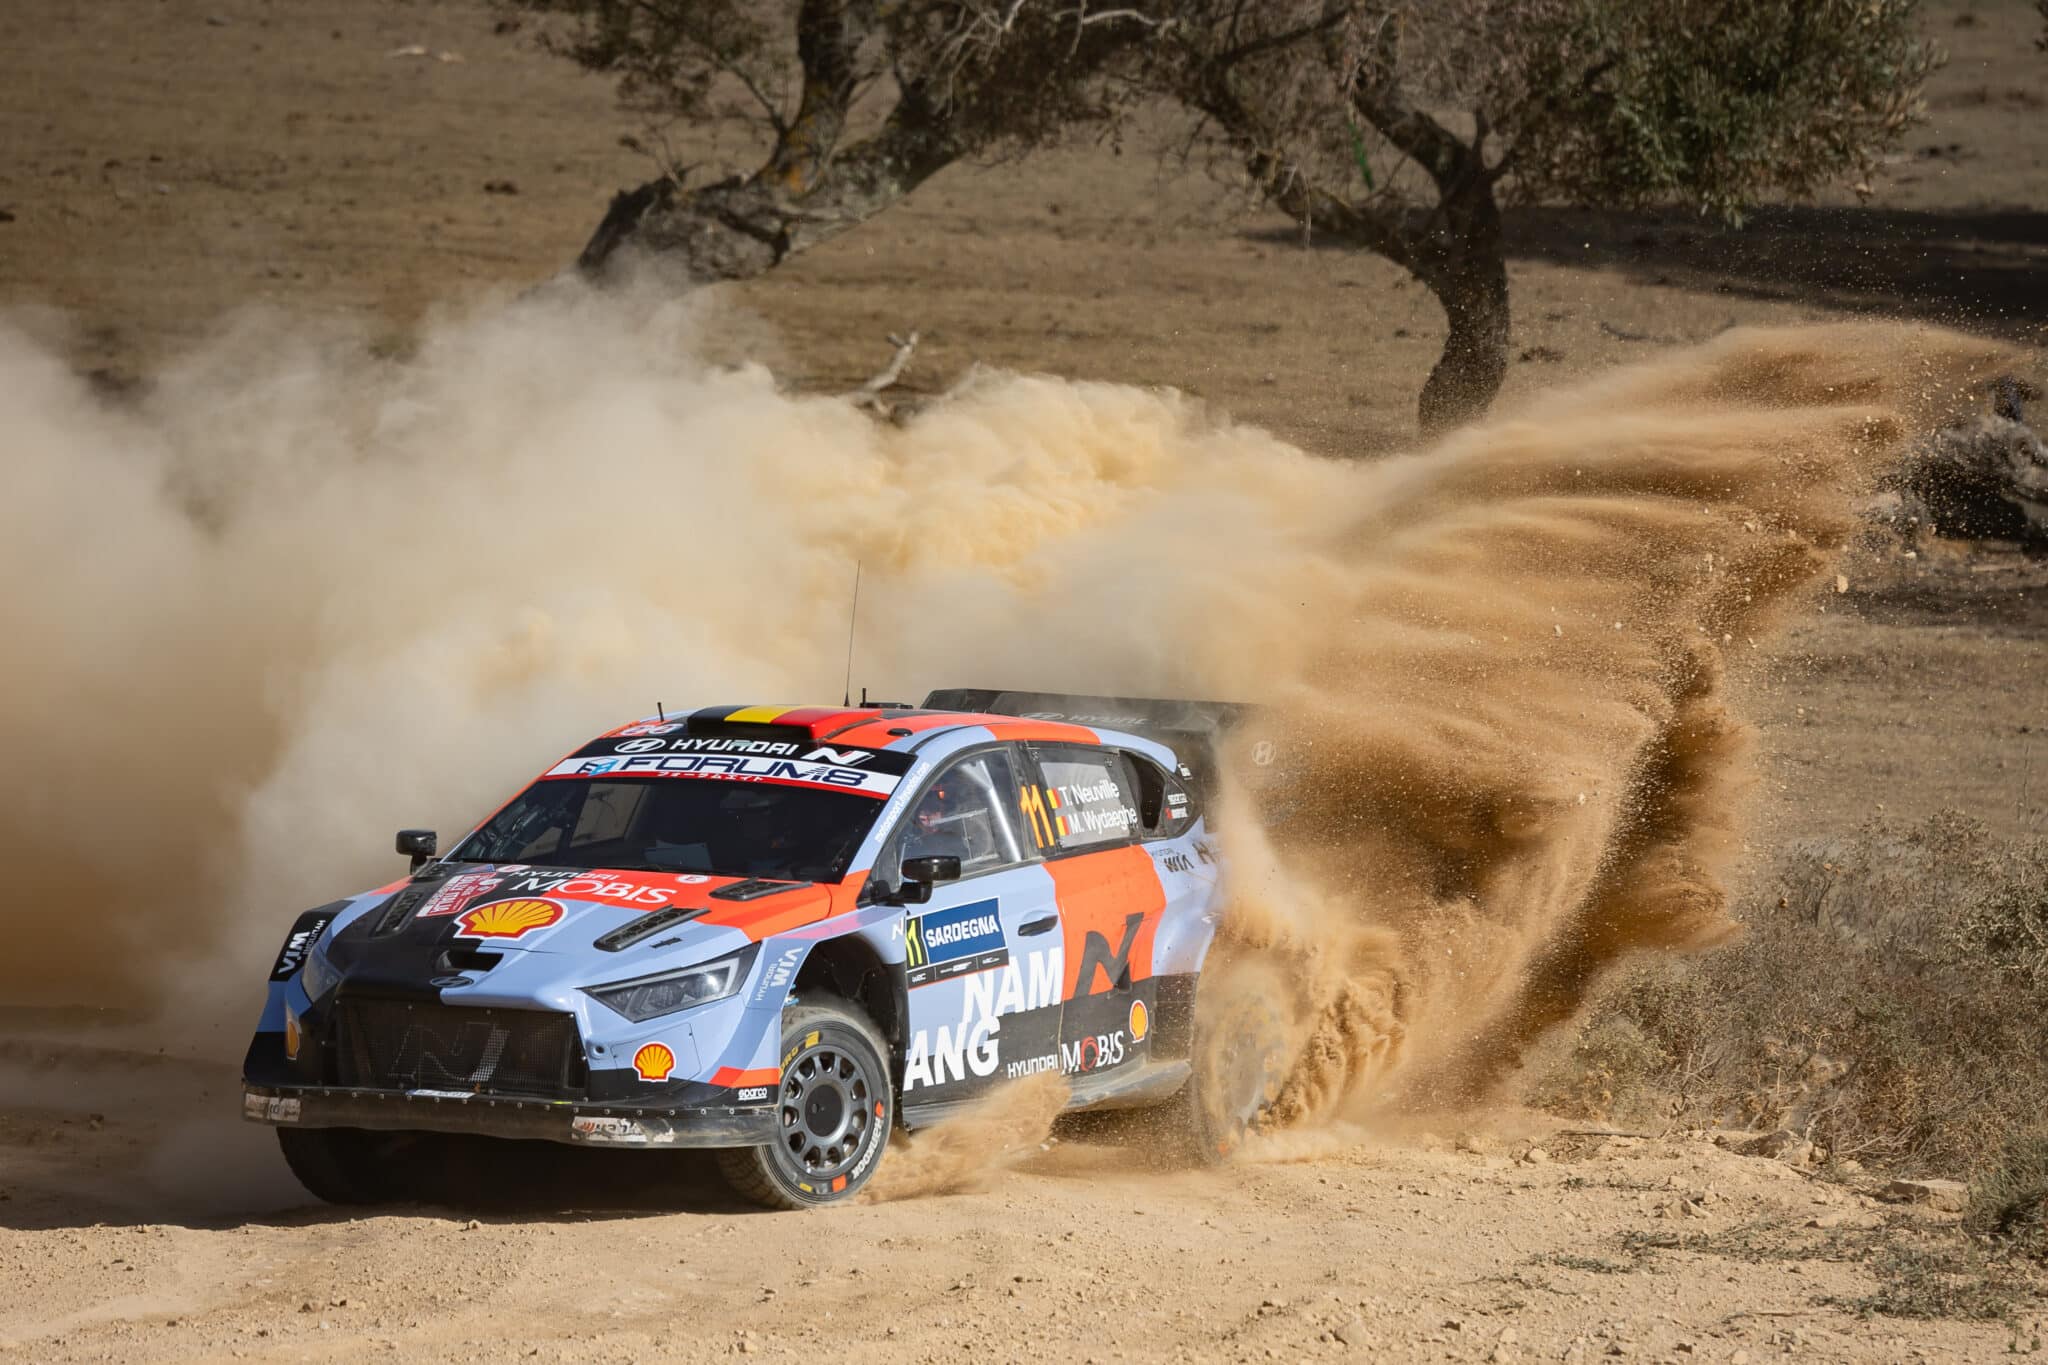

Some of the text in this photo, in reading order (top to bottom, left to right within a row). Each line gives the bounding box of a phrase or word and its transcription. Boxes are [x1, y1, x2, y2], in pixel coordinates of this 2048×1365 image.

[670, 738, 799, 756] HYUNDAI
[620, 756, 868, 787] FORUM8
[1058, 779, 1120, 807] T. Neuville
[1020, 784, 1055, 848] 11
[1067, 813, 1085, 834] M.
[1082, 804, 1138, 835] Wydaeghe
[508, 877, 678, 904] MOBIS
[509, 870, 621, 880] HYUNDAI
[925, 914, 1000, 948] SARDEGNA
[770, 947, 804, 987] WIA
[962, 946, 1062, 1023] NAM
[1007, 1030, 1125, 1080] HYUNDAI MOBIS
[738, 1086, 768, 1101] sparco
